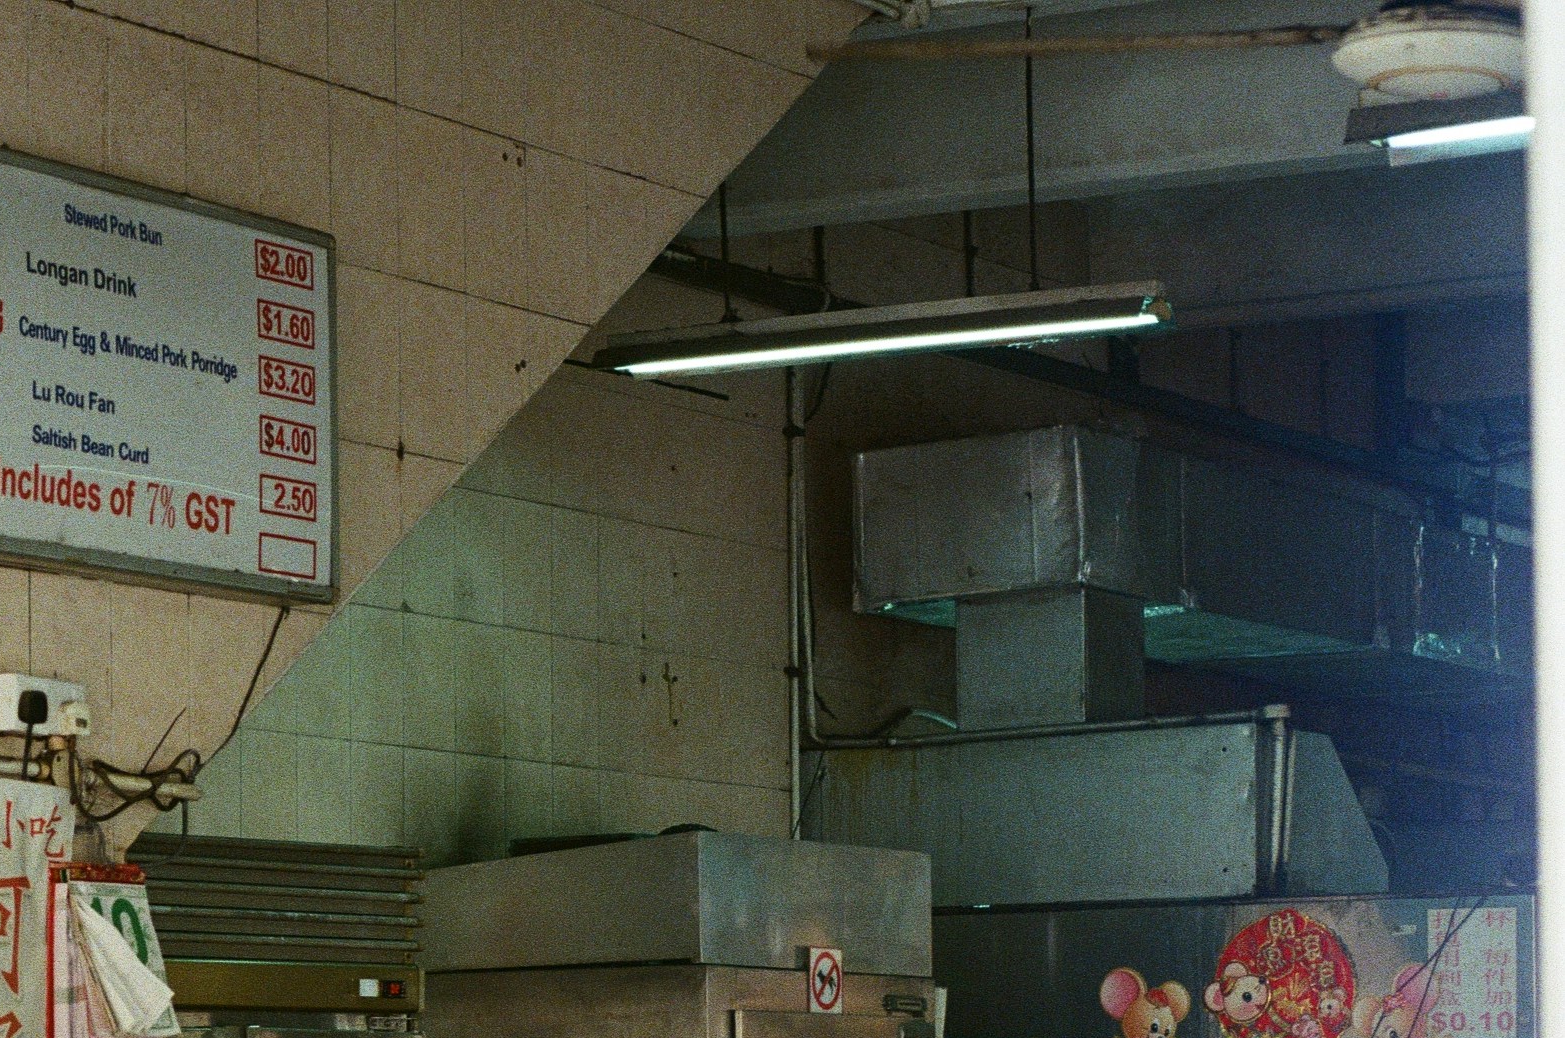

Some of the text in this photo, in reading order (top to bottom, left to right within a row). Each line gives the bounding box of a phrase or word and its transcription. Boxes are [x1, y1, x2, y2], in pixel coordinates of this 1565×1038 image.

[64, 203, 163, 246] Stewed Pork Bun
[26, 251, 137, 298] Longan Drink
[260, 245, 308, 283] $2.00
[261, 304, 311, 342] $1.60
[19, 316, 237, 380] Century Egg & Minced Pork Porridge
[32, 380, 115, 415] Lu Rou Fan
[261, 361, 313, 400] $3.20
[32, 425, 149, 465] Saltish Bean Curd
[263, 420, 313, 457] $4.00
[110, 477, 134, 518] of
[146, 481, 176, 530] 7%
[185, 492, 235, 535] GST
[273, 481, 314, 515] 2.50
[1432, 1009, 1514, 1033] $0.10
